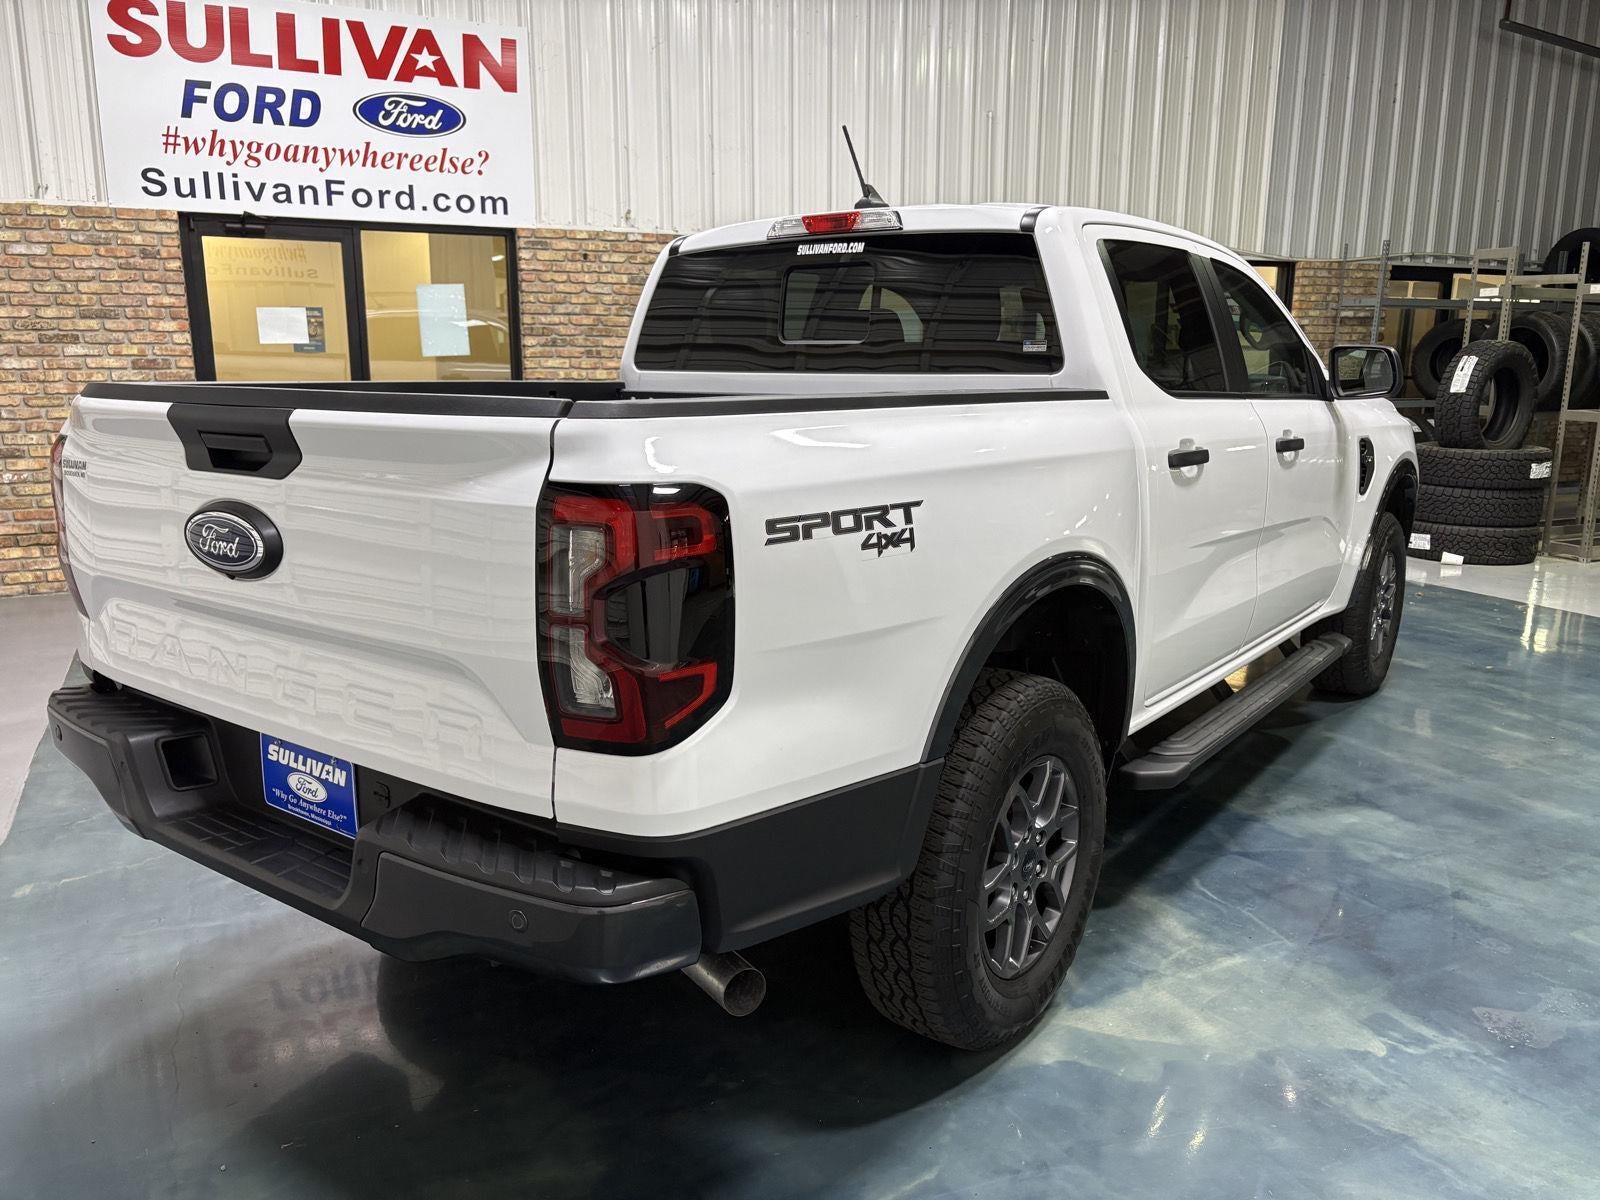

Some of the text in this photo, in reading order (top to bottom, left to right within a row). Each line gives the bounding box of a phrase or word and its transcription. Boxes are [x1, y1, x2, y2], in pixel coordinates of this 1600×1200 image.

[106, 0, 518, 93] SULLIVAN
[180, 79, 322, 128] FORD
[378, 96, 445, 131] Ford
[161, 125, 490, 177] #whygoanywhereelse?
[140, 167, 509, 216] SullivanFord.com
[797, 242, 865, 256] SULLIVANFORD.COM
[199, 523, 240, 558] Ford
[765, 499, 924, 547] SPORT
[109, 618, 486, 770] RANGER
[267, 744, 347, 787] SULLIVAN
[296, 777, 319, 799] Ford
[288, 794, 298, 804] Go
[298, 798, 327, 816] Anywhere
